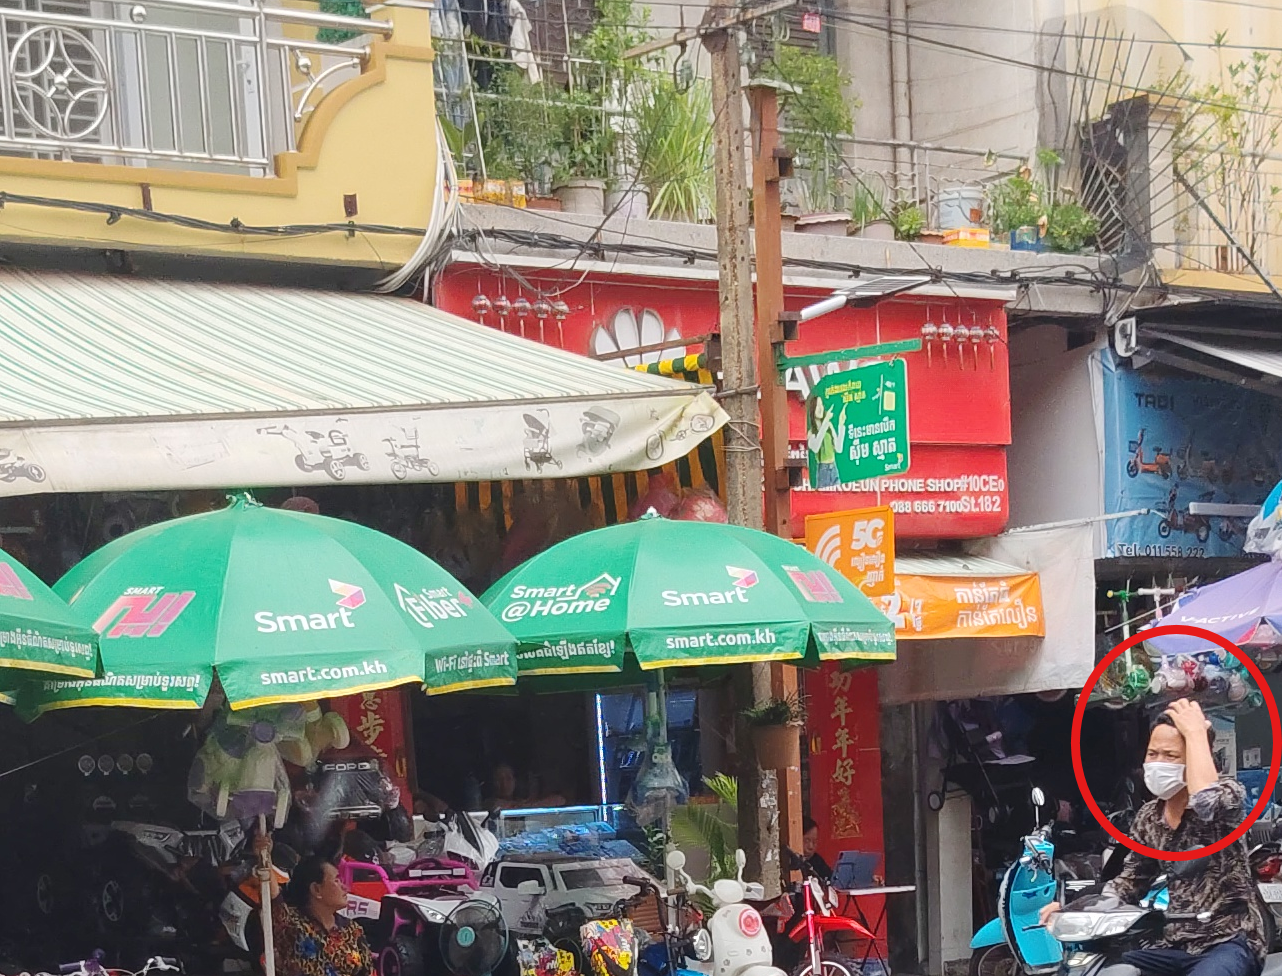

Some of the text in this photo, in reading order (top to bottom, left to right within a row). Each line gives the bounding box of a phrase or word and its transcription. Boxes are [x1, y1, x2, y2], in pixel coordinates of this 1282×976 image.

[880, 478, 926, 492] PHONE
[927, 478, 960, 492] SHOP
[914, 501, 936, 513] 666
[851, 518, 885, 550] 5G
[1145, 545, 1164, 557] 011
[124, 586, 165, 596] SMART
[423, 587, 452, 601] Smart
[510, 584, 576, 600] Smart
[661, 586, 749, 607] Smart
[254, 607, 355, 633] Smart
[501, 598, 612, 622] @Home
[666, 628, 776, 650] smart.com.kh
[261, 660, 388, 685] smart.com.kh
[434, 655, 457, 673] Wi-Fi
[483, 651, 510, 667] Smart
